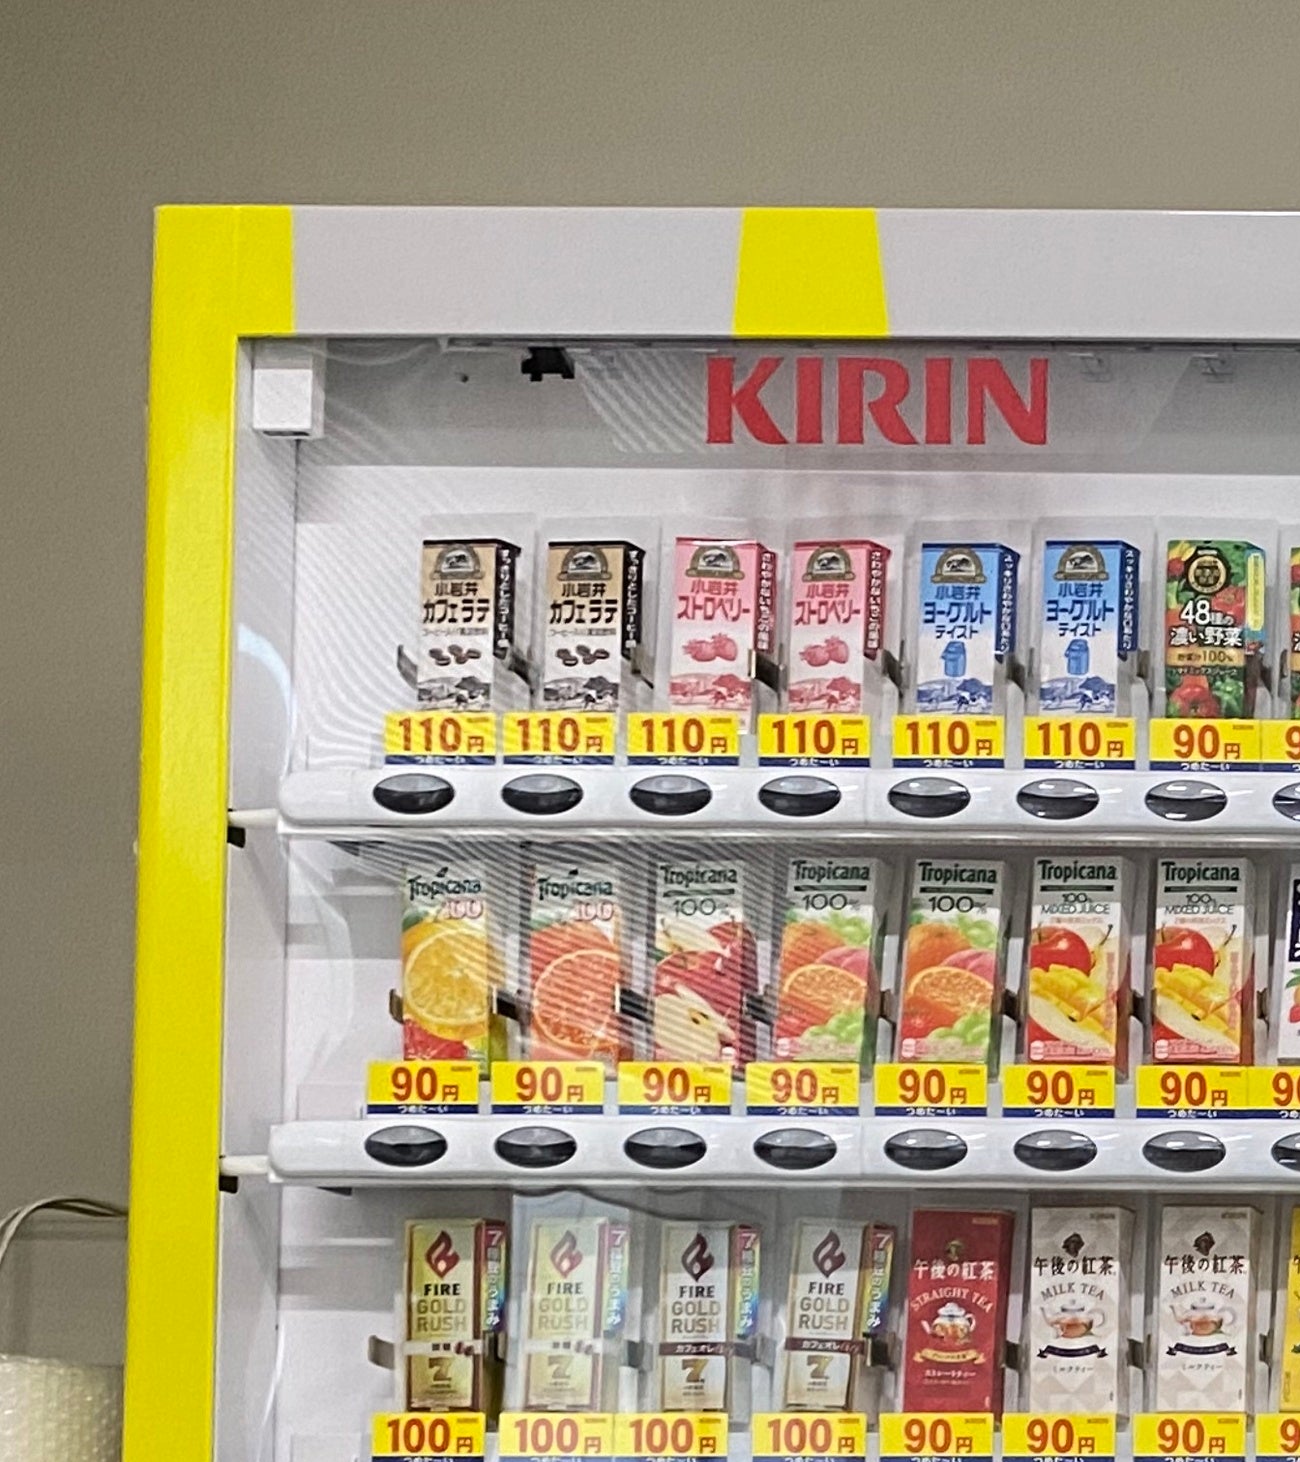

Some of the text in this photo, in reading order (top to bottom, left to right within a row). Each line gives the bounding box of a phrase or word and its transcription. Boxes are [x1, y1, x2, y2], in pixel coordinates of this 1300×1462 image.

[707, 356, 1049, 445] KIRIN
[423, 598, 491, 625] カフェラテ
[677, 597, 751, 620] ストロベリー
[923, 600, 992, 623] ヨーグルト
[399, 718, 485, 753] 110円
[772, 720, 859, 755] 110円
[1173, 725, 1241, 759] 90円
[793, 861, 871, 880] Tropicana
[919, 863, 998, 884] Tropicana
[391, 1068, 459, 1102] 90円
[899, 1071, 968, 1105] 90円
[914, 1261, 995, 1280] 午後の紅茶
[1034, 1255, 1113, 1275] 午後の紅茶
[424, 1284, 461, 1296] FIRE
[1041, 1282, 1105, 1300] MILK TEA
[417, 1299, 467, 1315] GOLD
[417, 1316, 467, 1332] RUSH
[387, 1419, 473, 1453] 100円
[904, 1419, 973, 1453] 90円
